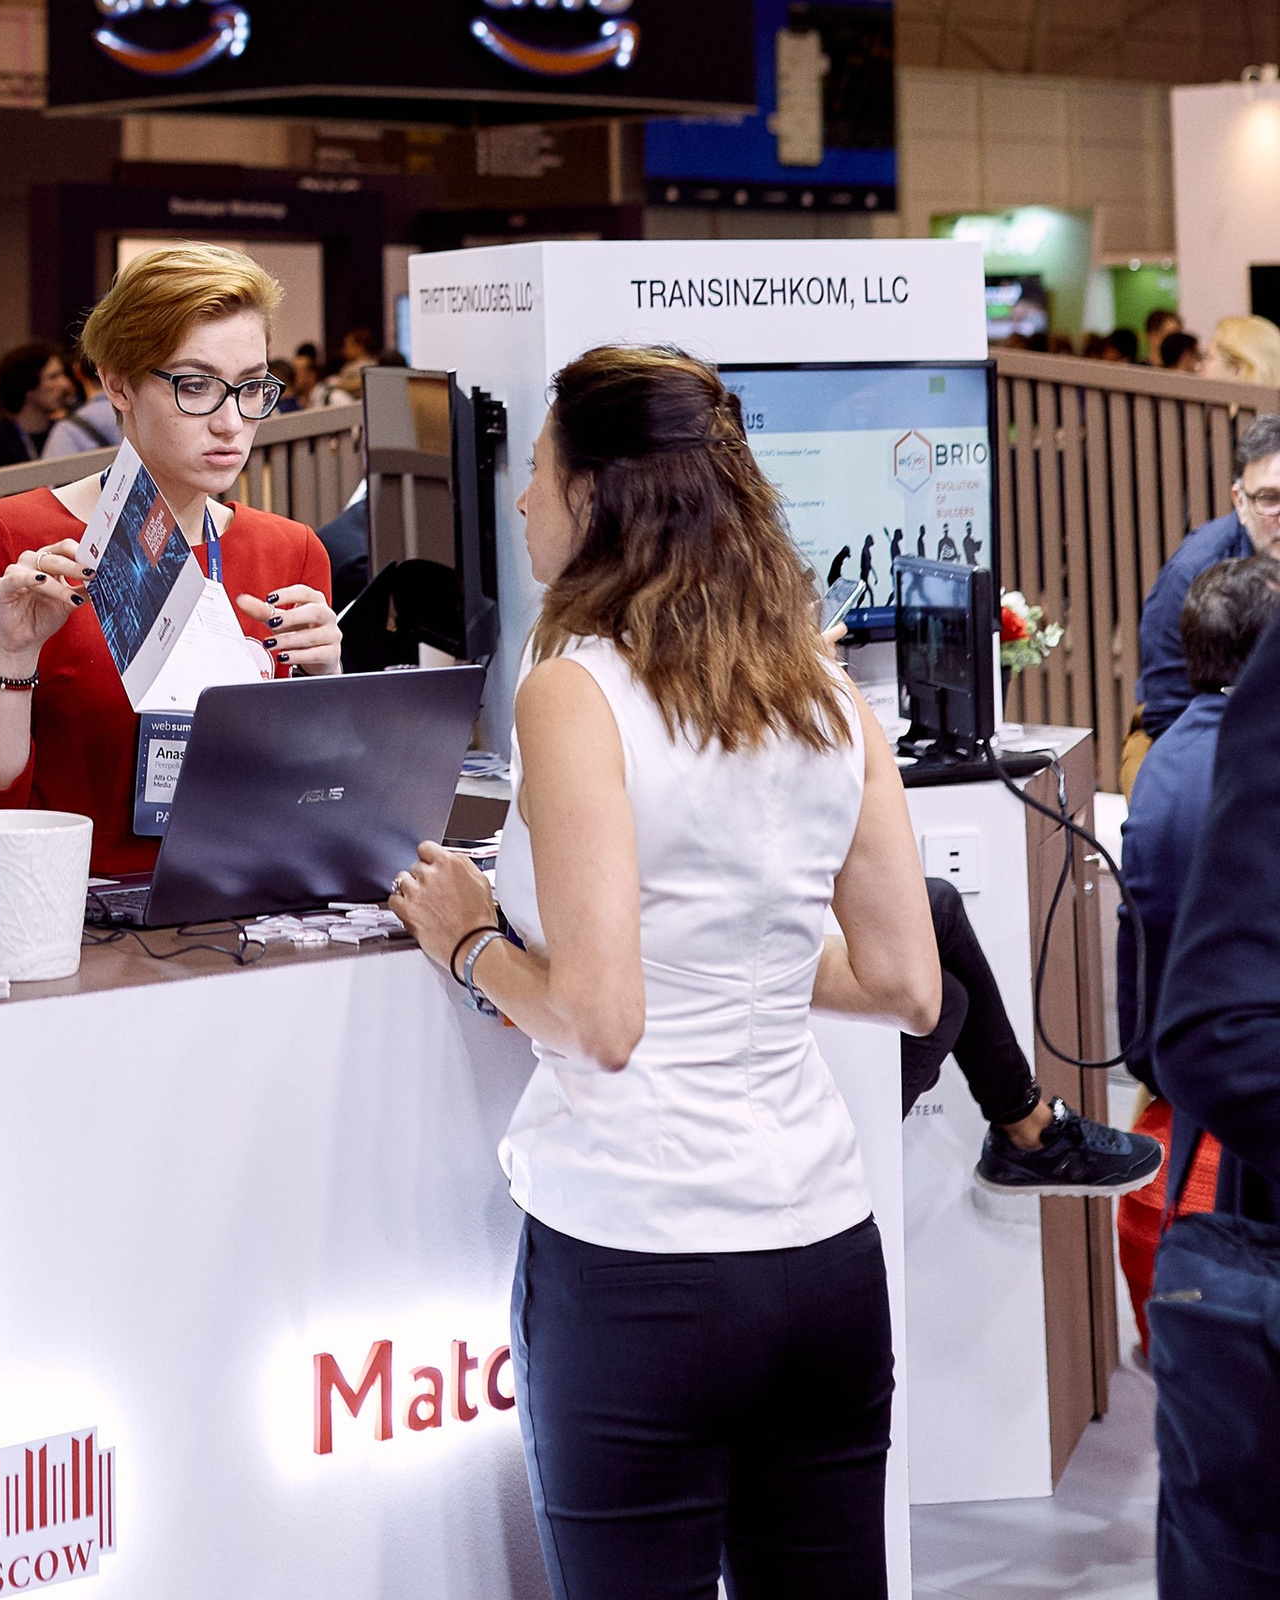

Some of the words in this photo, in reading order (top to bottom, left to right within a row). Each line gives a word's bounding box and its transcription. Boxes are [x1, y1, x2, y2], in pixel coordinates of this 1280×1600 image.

[631, 277, 854, 309] TRANSINZHKOM,
[864, 276, 909, 304] LLC
[935, 443, 988, 466] BRIO
[936, 481, 979, 492] EVOLUTION
[936, 507, 975, 519] BUILDERS
[297, 787, 345, 804] ASUS
